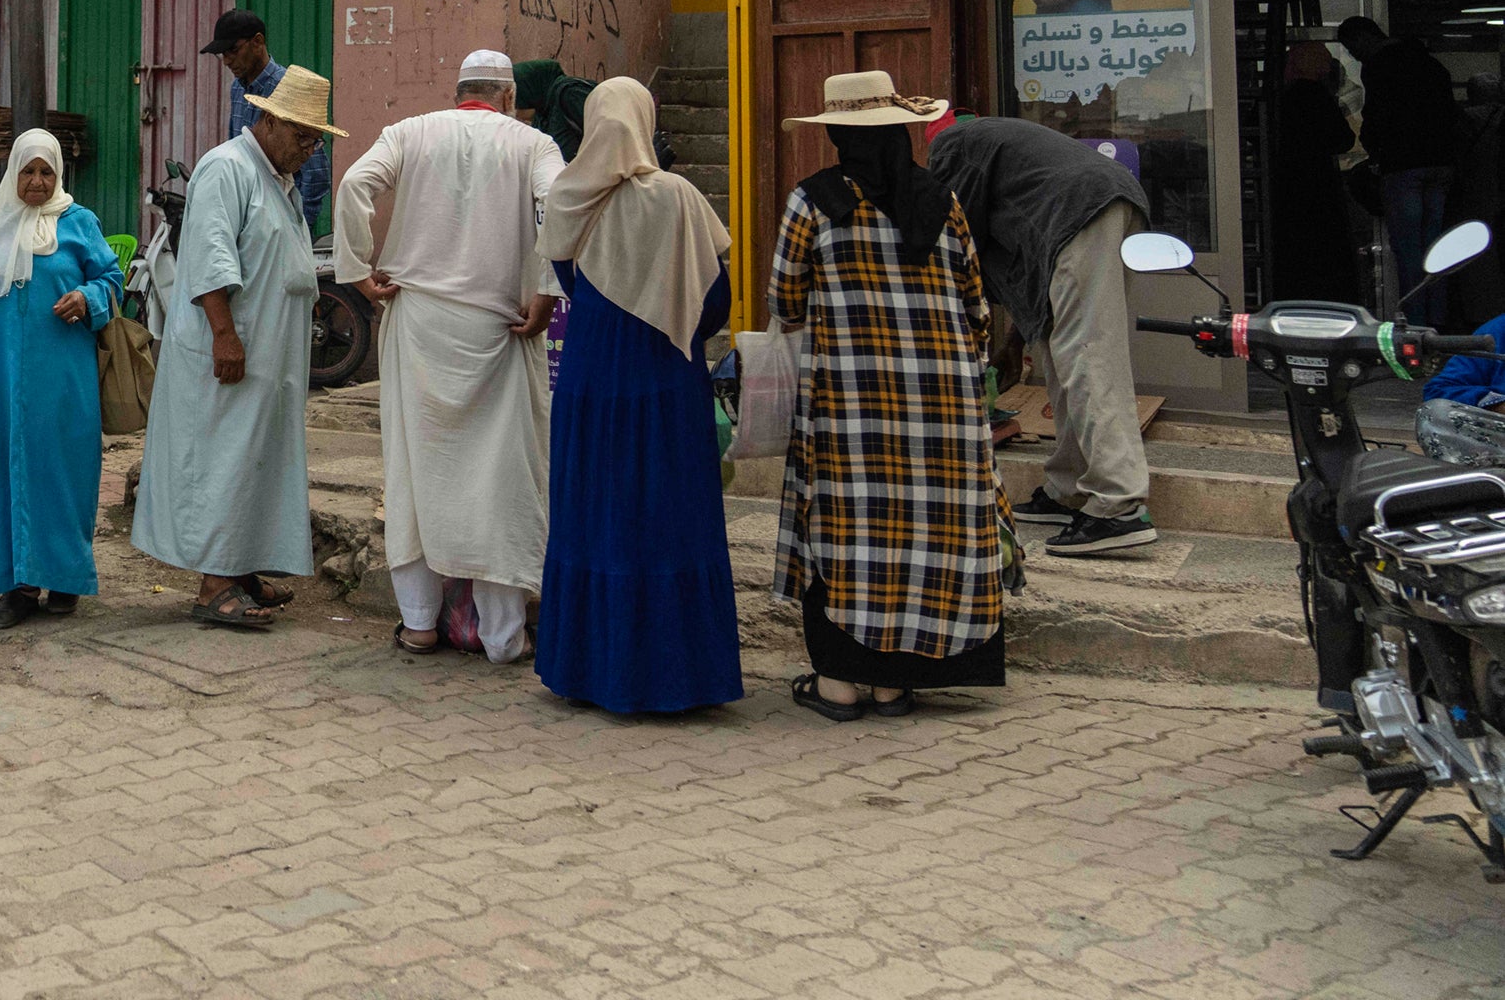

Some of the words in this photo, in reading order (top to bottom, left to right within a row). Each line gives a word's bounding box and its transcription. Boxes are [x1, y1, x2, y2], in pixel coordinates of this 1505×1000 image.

[1021, 22, 1082, 47] تسلم
[1089, 24, 1102, 45] و
[1110, 17, 1187, 43] صيفط
[1022, 50, 1090, 78] ديالك
